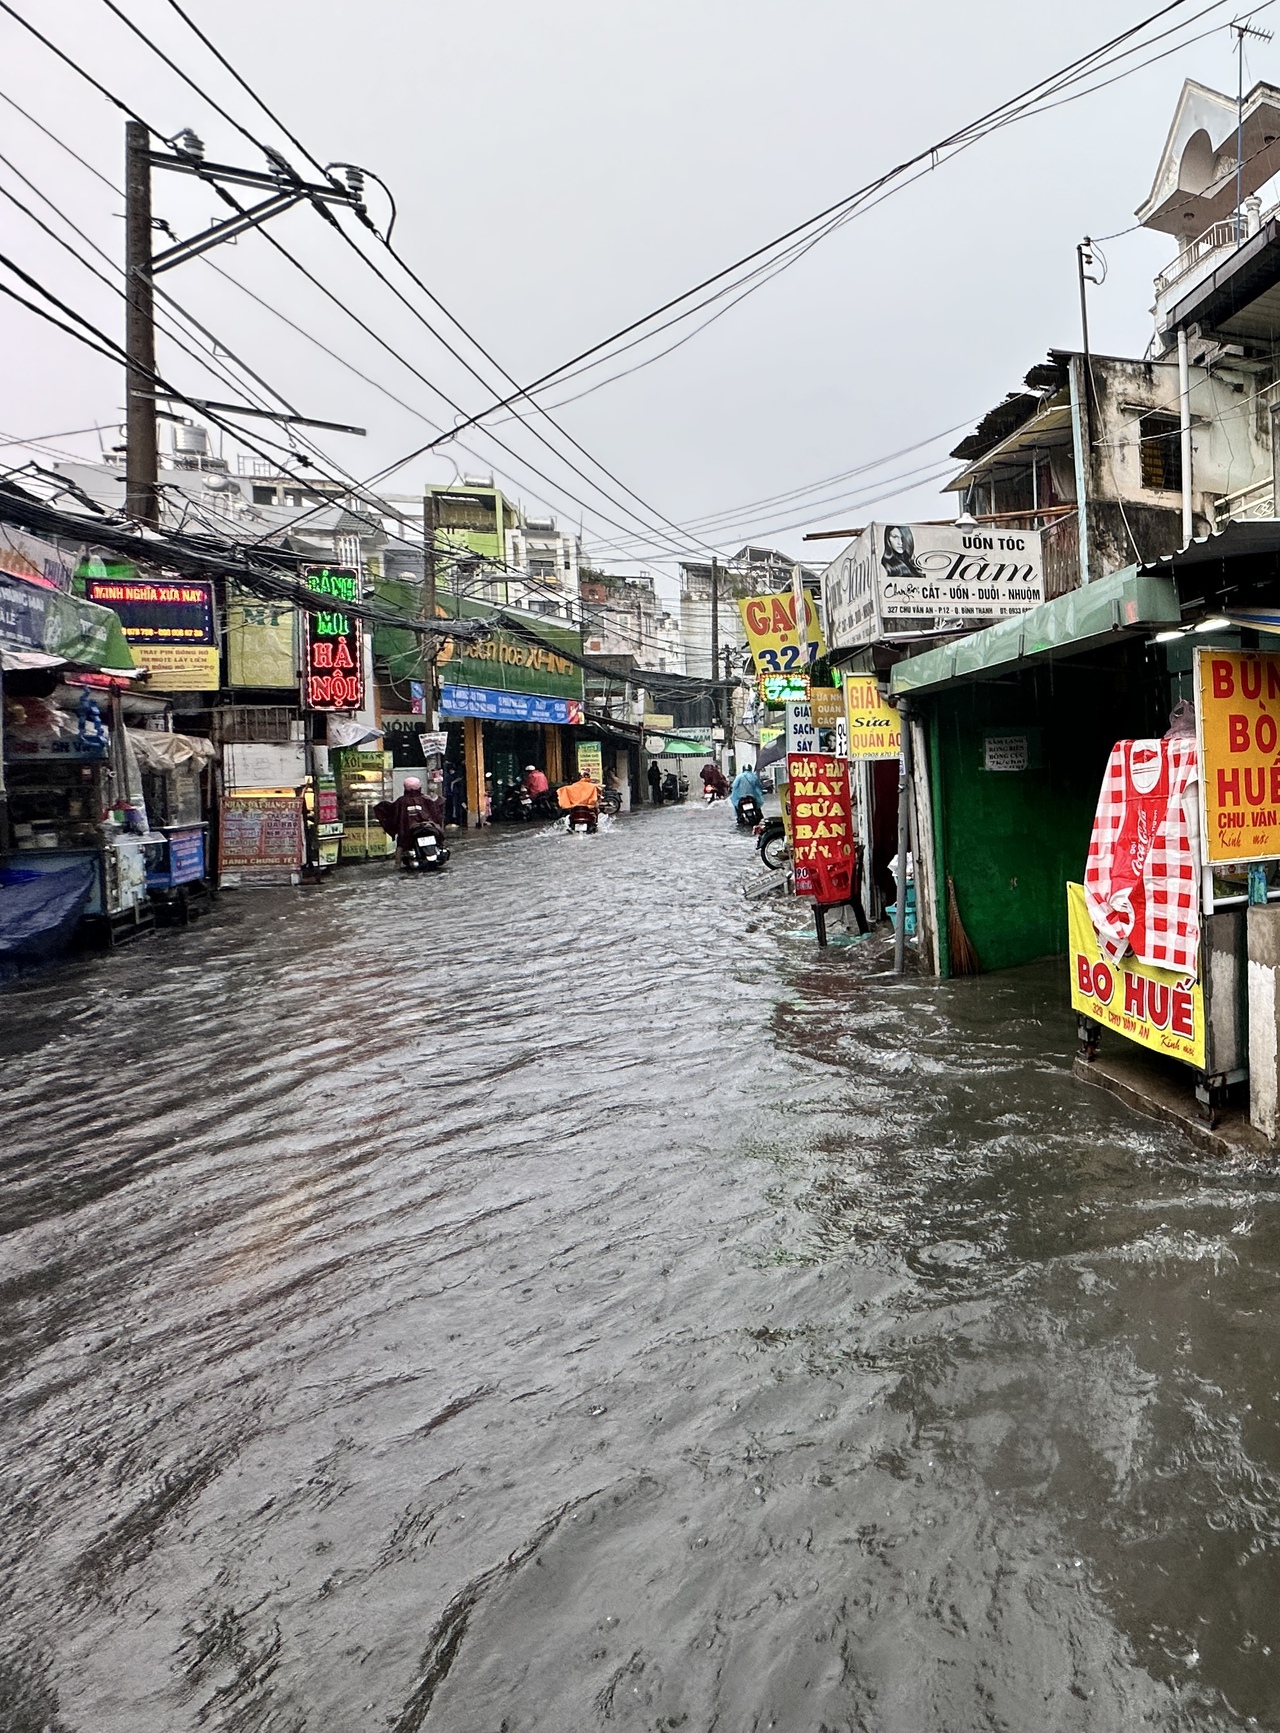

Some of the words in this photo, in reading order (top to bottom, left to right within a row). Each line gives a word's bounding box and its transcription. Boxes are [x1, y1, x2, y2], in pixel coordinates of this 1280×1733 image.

[962, 533, 993, 550] UỐN
[998, 535, 1025, 550] TÓC
[915, 550, 1038, 582] Tâm
[95, 587, 124, 599] MINH
[182, 589, 202, 602] NAY
[922, 583, 940, 599] CẮT
[950, 583, 969, 600] UỐN
[1008, 588, 1040, 603] NHUỘM
[747, 597, 812, 642] GẠO
[912, 605, 924, 614] VĂN
[955, 607, 961, 615] Q.
[961, 605, 975, 614] BÌNH
[314, 636, 353, 667] HÀ
[525, 646, 573, 676] XANH
[758, 642, 819, 674] 327
[312, 669, 358, 706] NỘI
[818, 703, 841, 714] QUẦN
[793, 724, 815, 738] SẠCH
[853, 717, 890, 727] Sửa
[1228, 700, 1277, 754] BÒ
[797, 735, 813, 751] SẤY
[853, 729, 887, 749] QUẦN
[790, 758, 817, 781] GIẶT
[825, 758, 844, 777] HẤP
[794, 781, 844, 796] MAY
[796, 798, 845, 817] SỬA
[795, 821, 846, 840] BÁN
[1124, 978, 1196, 1041] HUẾ
[1092, 1002, 1103, 1018] 329
[1108, 1010, 1120, 1027] CHU
[1139, 1024, 1150, 1040] AN
